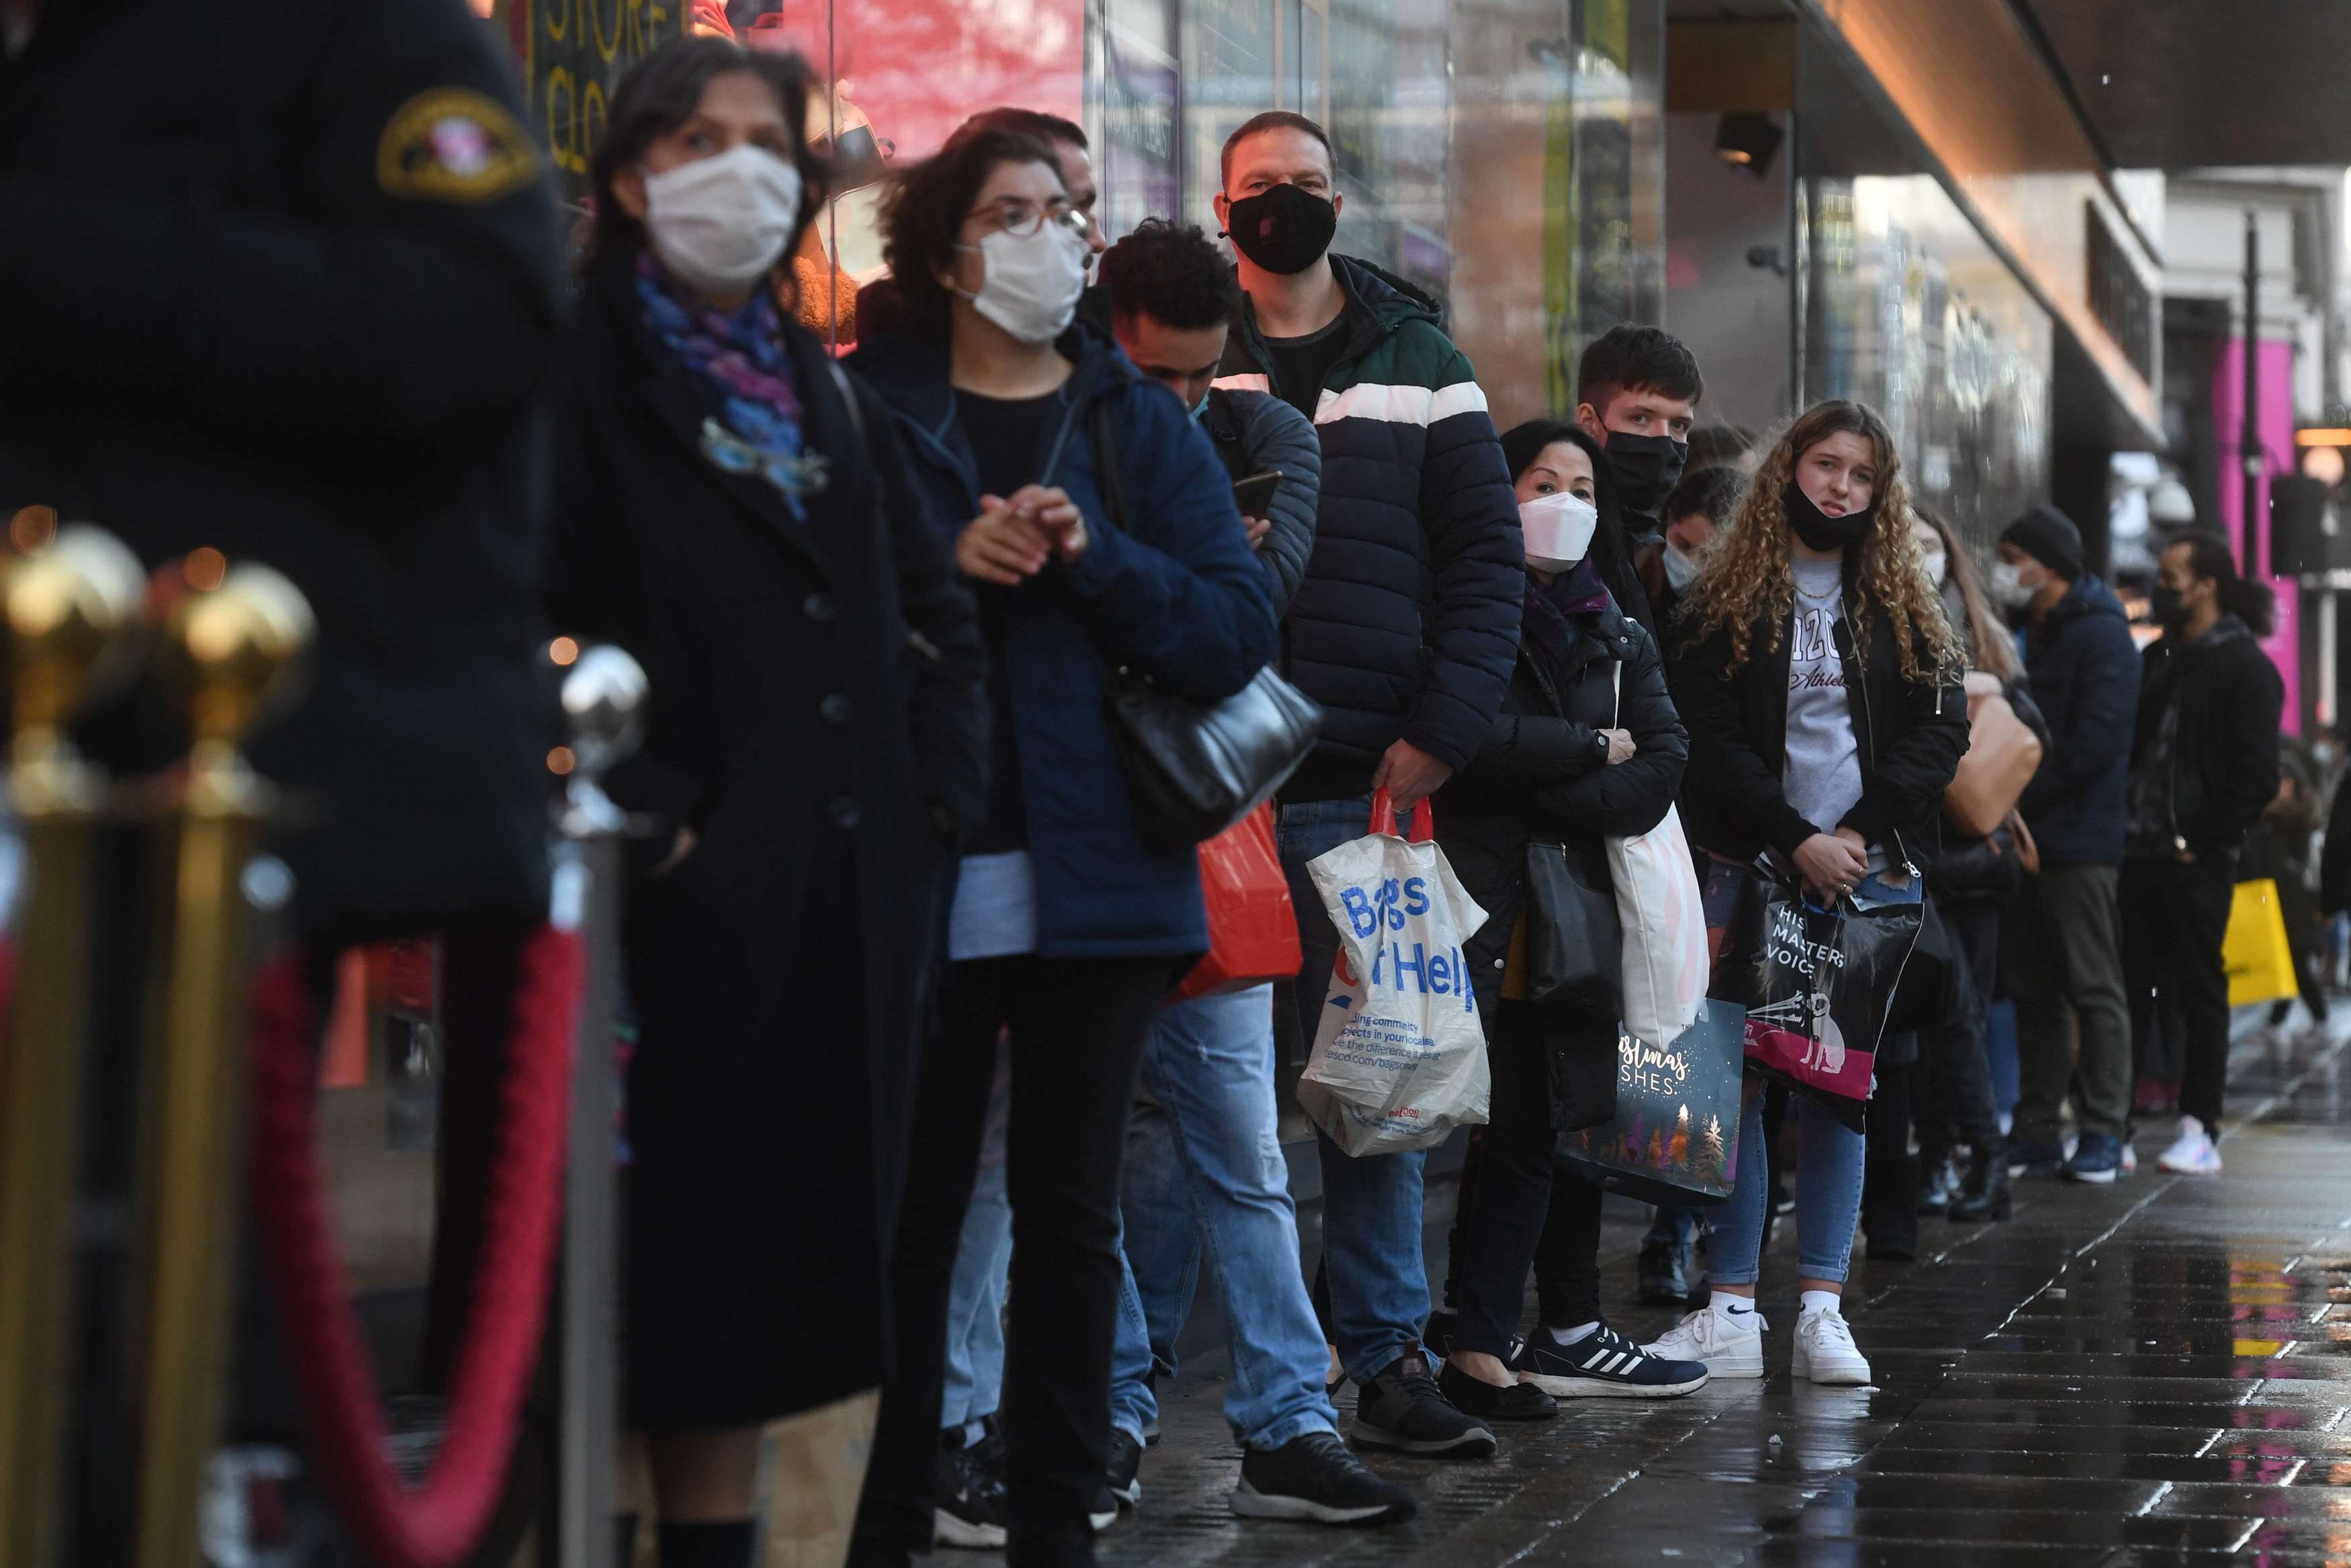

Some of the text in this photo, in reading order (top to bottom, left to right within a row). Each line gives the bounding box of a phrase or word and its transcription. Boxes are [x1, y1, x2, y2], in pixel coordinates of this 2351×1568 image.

[1385, 1033, 1405, 1042] your
[1348, 1040, 1364, 1050] the
[1366, 1043, 1411, 1057] difference
